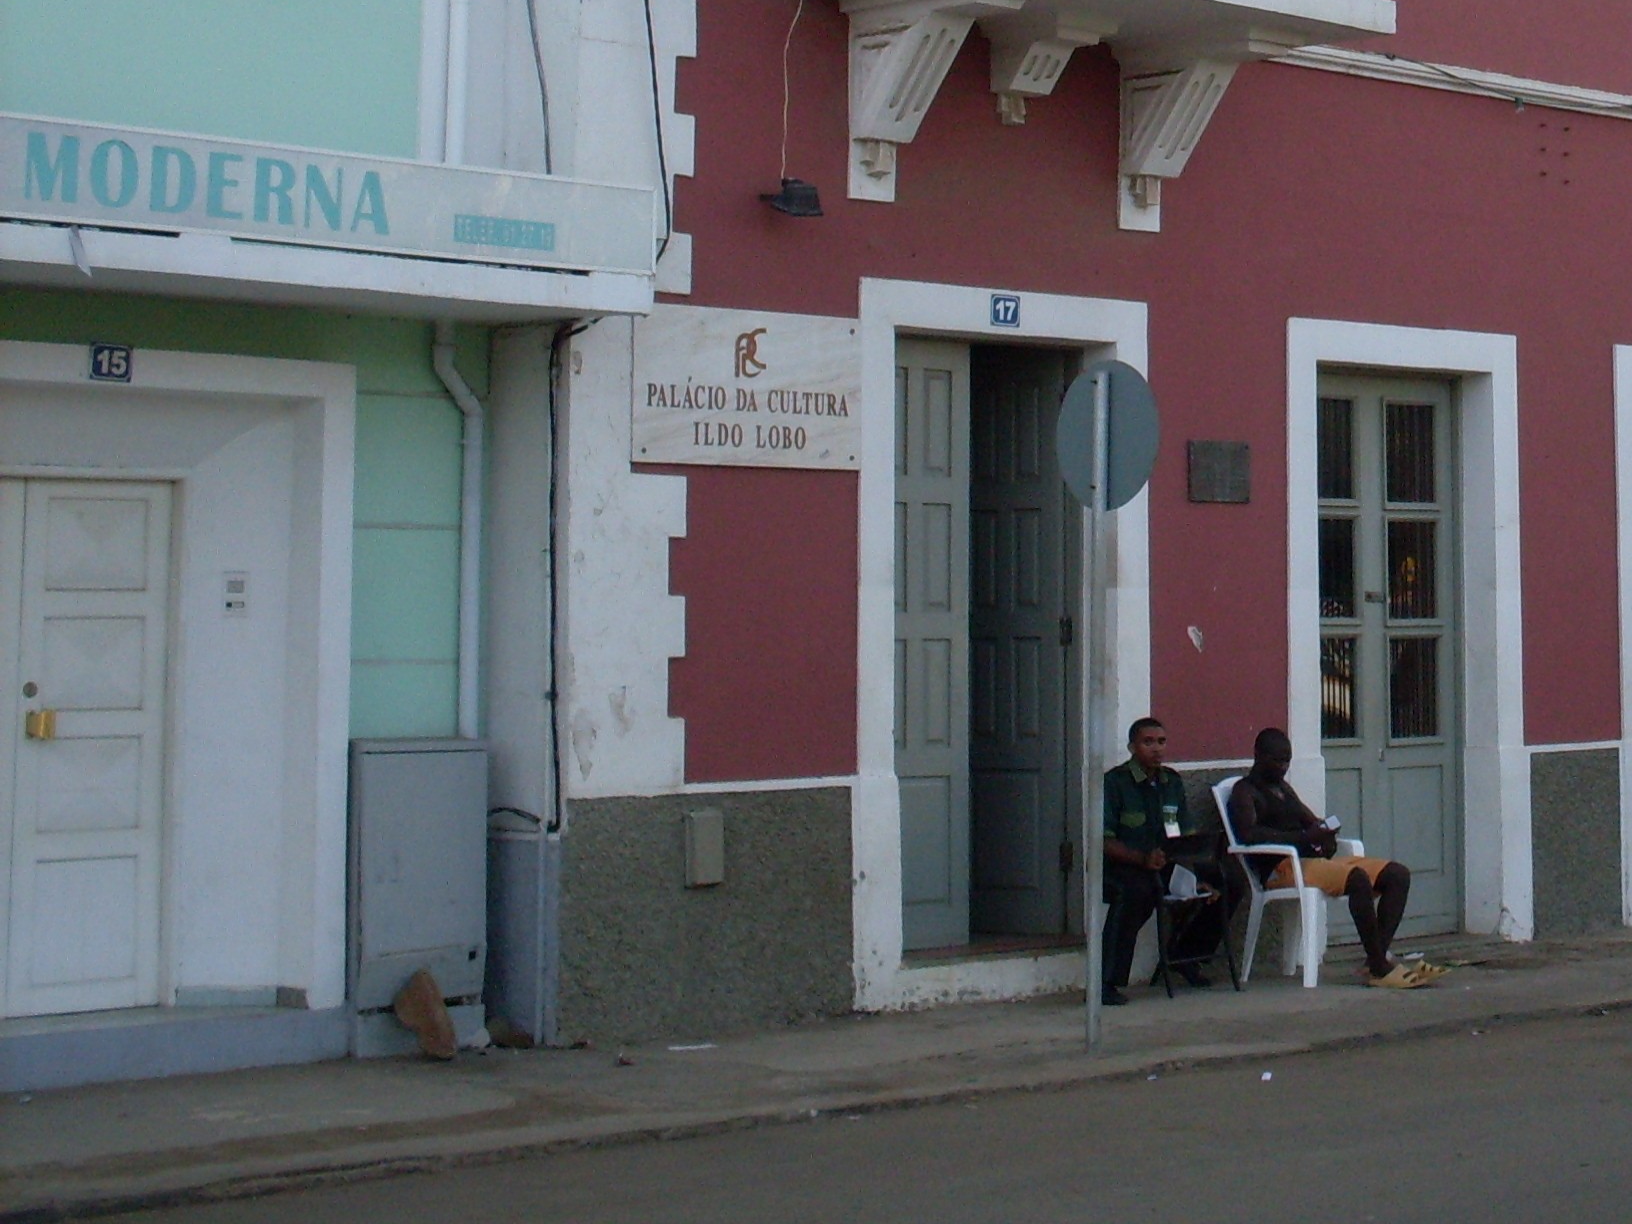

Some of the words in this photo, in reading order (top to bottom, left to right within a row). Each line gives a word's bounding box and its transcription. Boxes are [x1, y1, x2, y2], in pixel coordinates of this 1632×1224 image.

[24, 131, 390, 236] MODERNA
[995, 299, 1017, 321] 17
[97, 351, 127, 377] 15
[646, 376, 727, 410] PALÁCIO
[735, 388, 758, 412] DA
[767, 389, 849, 417] CULTURA
[692, 421, 743, 448] ILDO
[755, 424, 807, 450] LOBO
